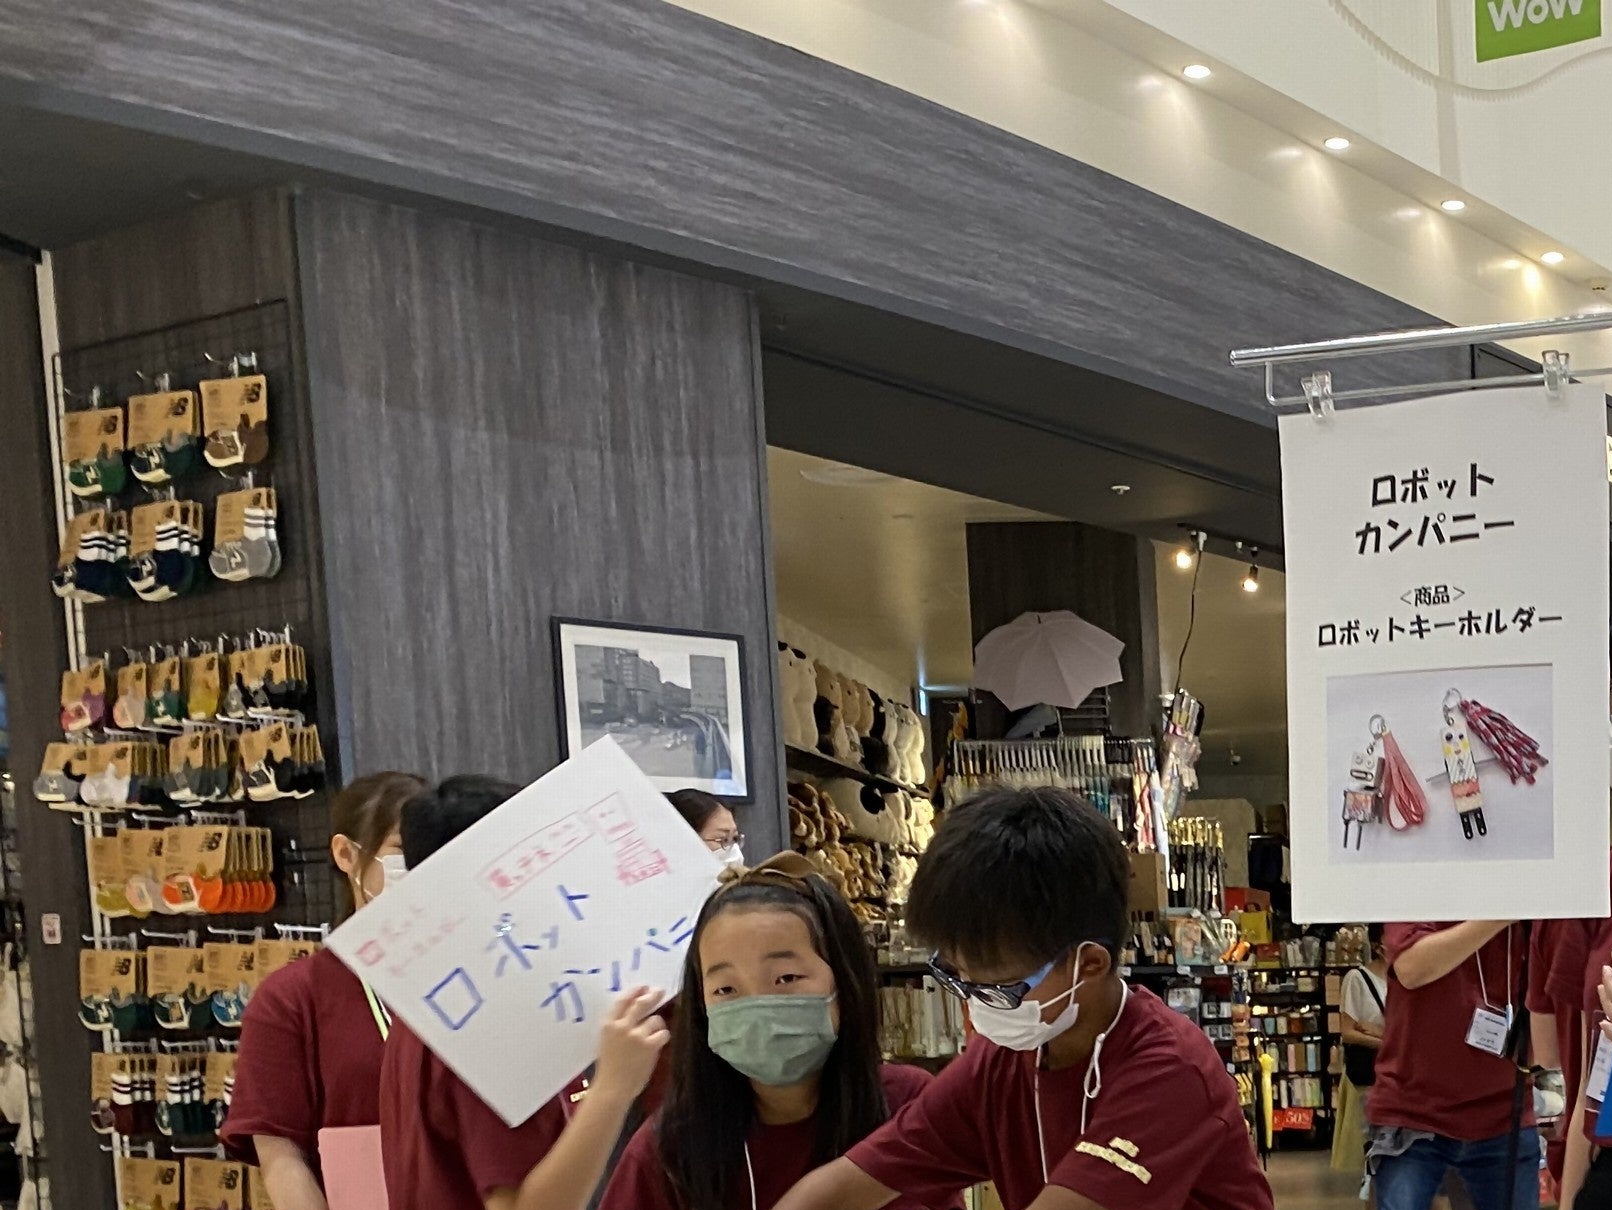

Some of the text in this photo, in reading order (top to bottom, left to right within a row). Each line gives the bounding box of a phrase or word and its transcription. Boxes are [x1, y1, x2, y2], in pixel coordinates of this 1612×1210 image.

[1371, 462, 1495, 508] ロボット
[1355, 511, 1515, 555] カンパニー
[1318, 605, 1563, 648] ロボットキーホルダー
[423, 884, 590, 1031] ロボット
